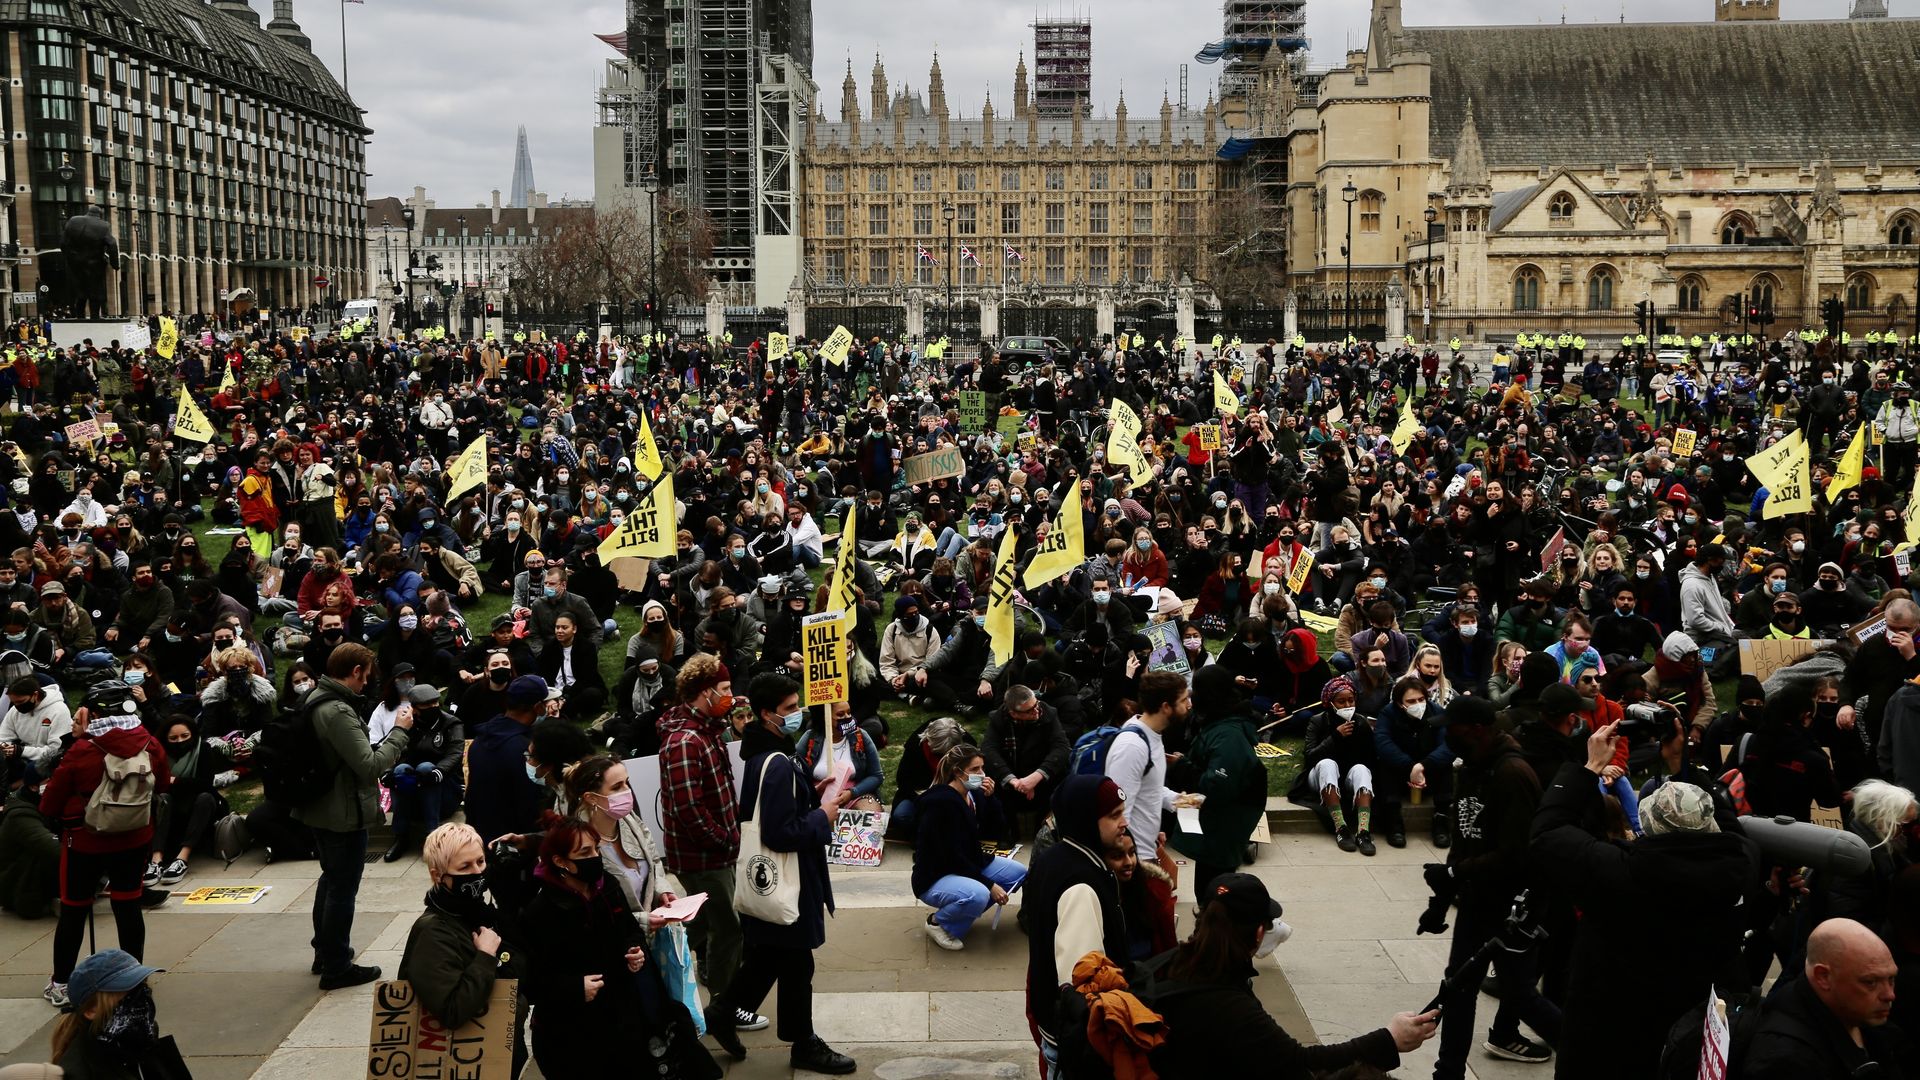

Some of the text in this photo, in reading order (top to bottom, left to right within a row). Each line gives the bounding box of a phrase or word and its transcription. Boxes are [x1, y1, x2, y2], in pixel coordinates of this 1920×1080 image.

[1220, 396, 1232, 406] ILL
[960, 408, 985, 416] PEOPLE
[1678, 432, 1693, 440] KILL
[808, 625, 840, 646] KILL
[1860, 628, 1870, 637] THE
[1870, 619, 1887, 631] POLIC
[808, 643, 836, 664] THE
[1751, 640, 1772, 661] WE
[809, 661, 841, 681] BILL
[811, 694, 833, 702] POWERS
[417, 1006, 448, 1052] NO
[504, 1021, 516, 1052] AUDRE
[450, 1031, 484, 1080] ECT
